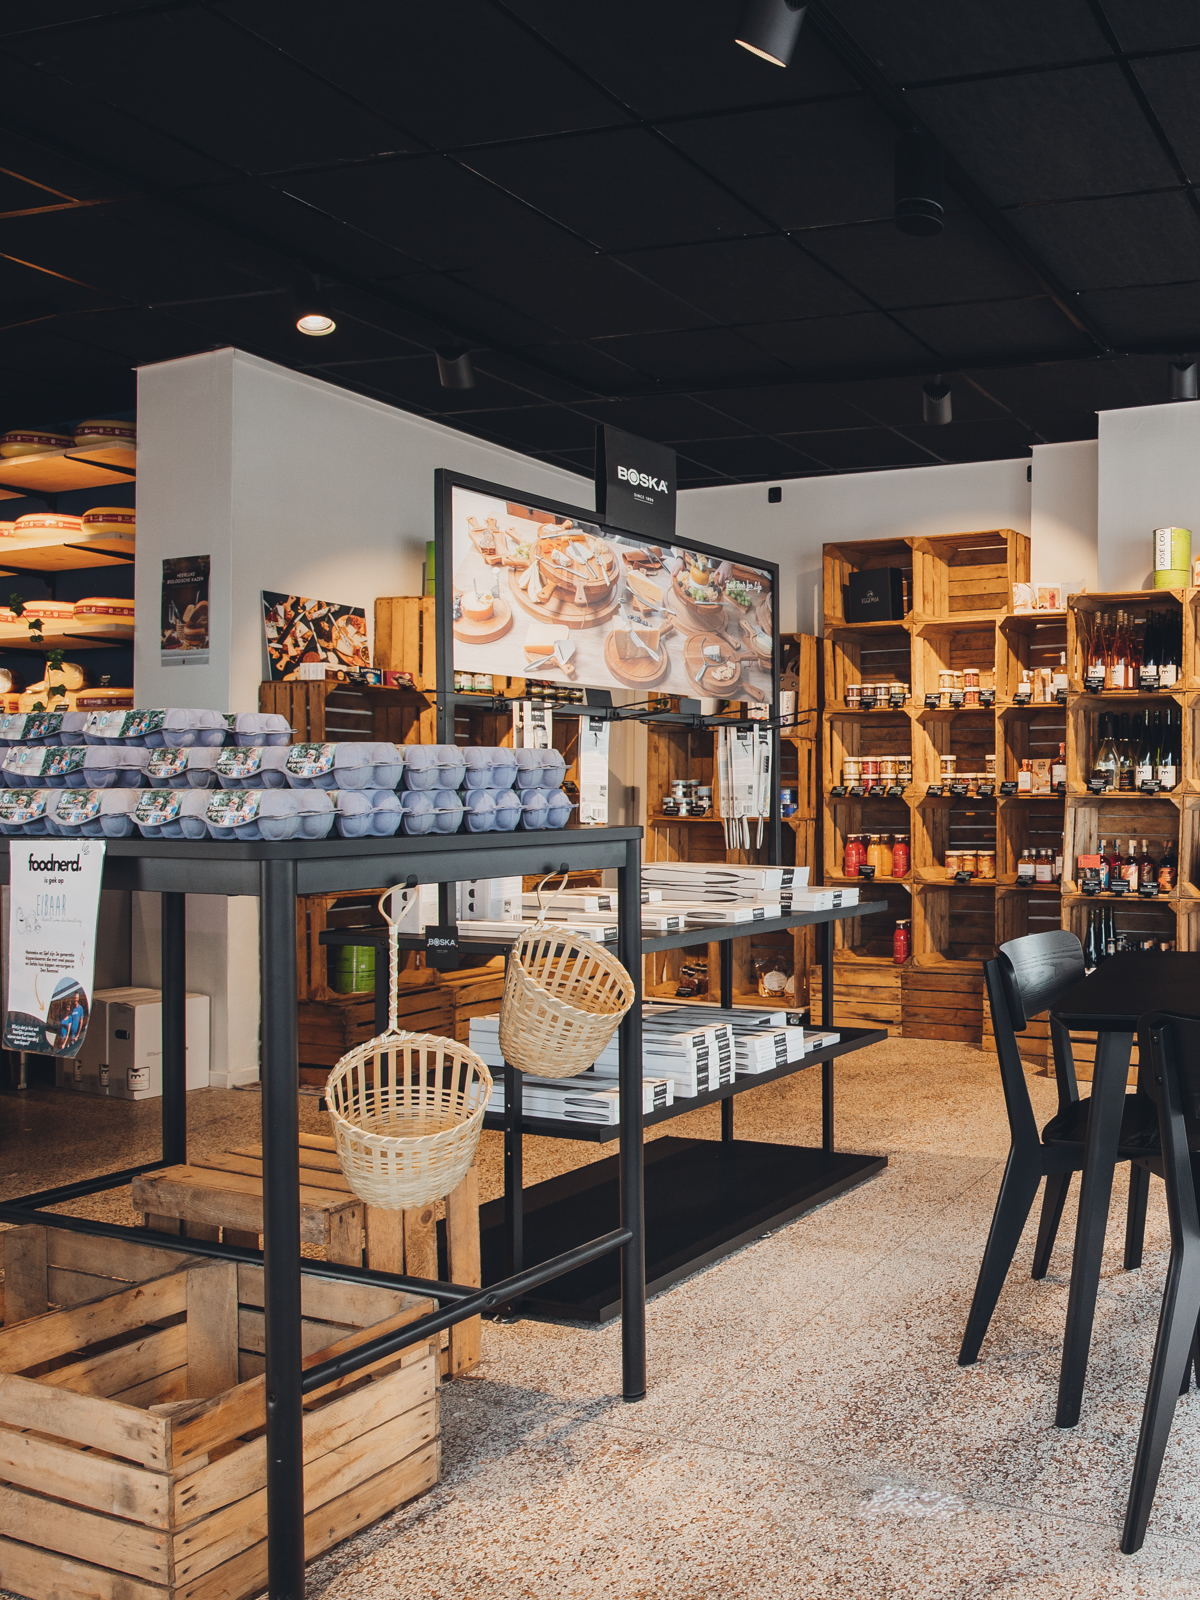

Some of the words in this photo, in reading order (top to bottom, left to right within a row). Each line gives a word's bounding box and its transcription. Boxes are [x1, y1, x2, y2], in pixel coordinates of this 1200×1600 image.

[617, 465, 669, 494] BOSKA
[28, 853, 82, 872] foodnerd.
[49, 877, 57, 885] gek
[36, 894, 67, 916] EIBAAR
[428, 938, 456, 946] BOSKA
